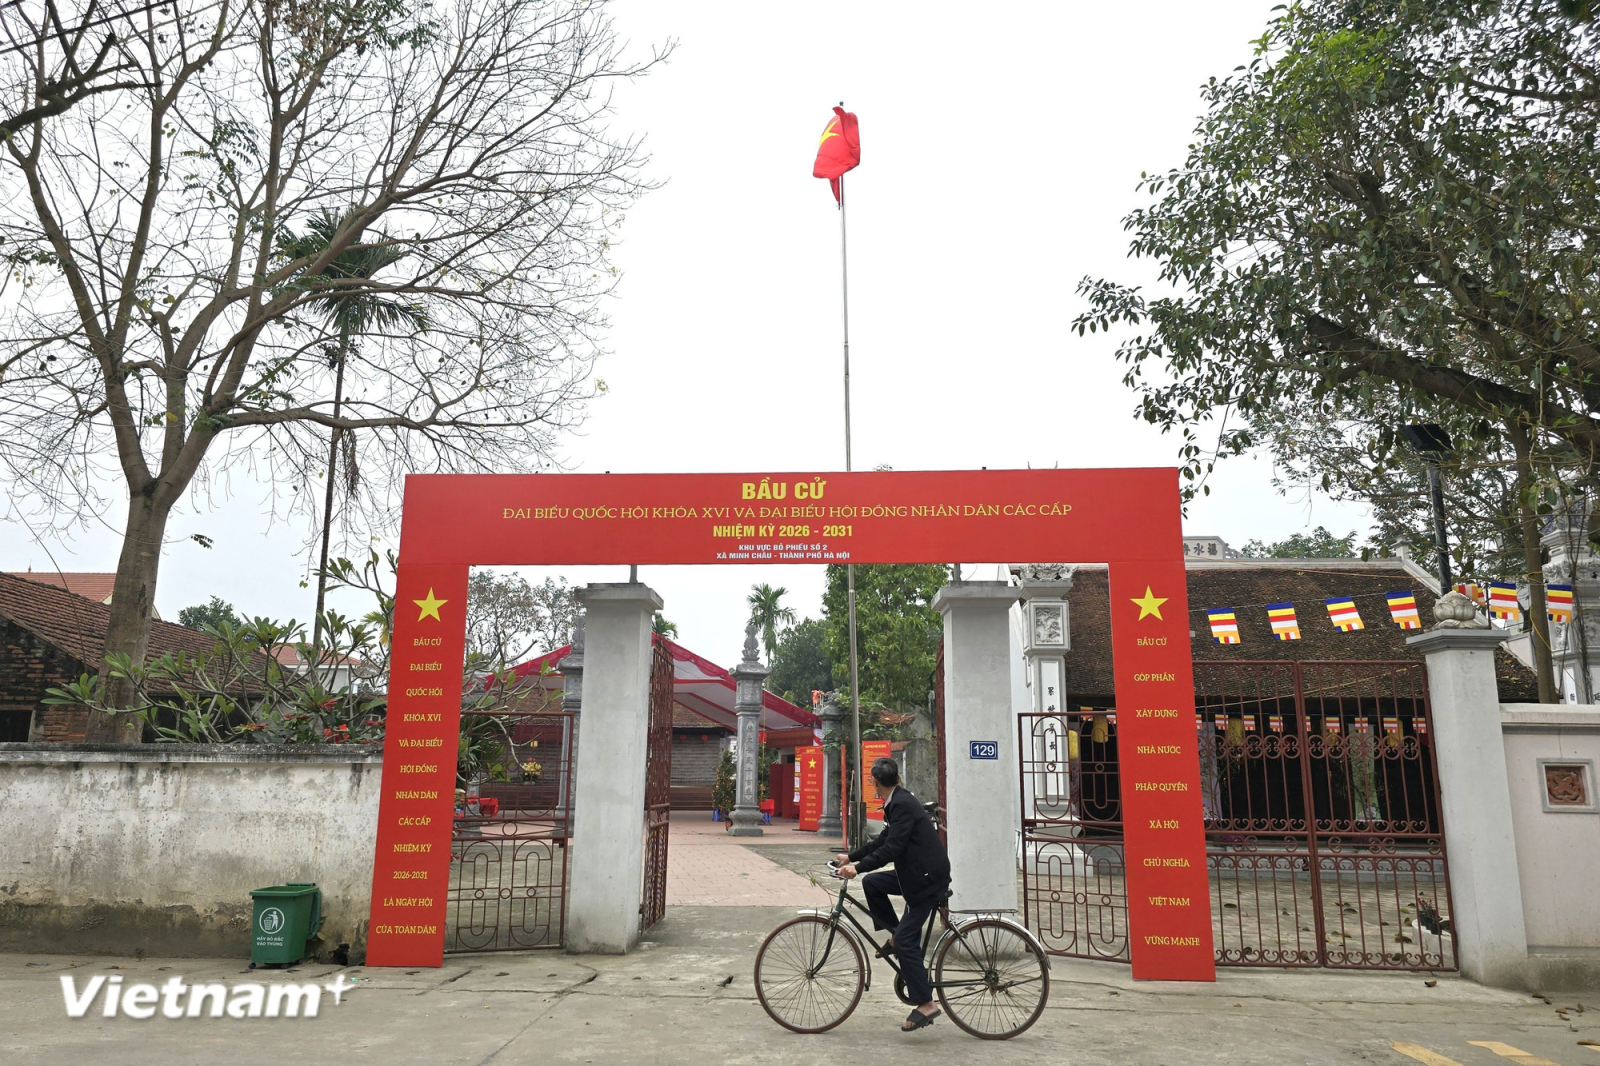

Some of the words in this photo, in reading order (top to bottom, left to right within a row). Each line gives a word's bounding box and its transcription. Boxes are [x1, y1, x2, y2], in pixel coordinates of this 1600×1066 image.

[742, 477, 786, 499] BẦU
[795, 477, 826, 499] CỬ
[503, 508, 531, 520] ĐẠI
[534, 505, 569, 518] BIỂU
[573, 505, 617, 520] QUỐC
[621, 506, 648, 519] HỘI
[653, 506, 698, 518] KHÓA
[702, 507, 729, 518] XVI
[733, 506, 756, 517] VÀ
[759, 507, 787, 519] ĐẠI
[791, 503, 825, 517] BIỂU
[829, 505, 857, 518] HỘI
[861, 503, 907, 517] ĐỒNG
[911, 504, 960, 516] NHÂN
[964, 504, 999, 516] DÂN
[1003, 503, 1036, 515] CÁC
[1039, 502, 1072, 515] CẤP
[713, 523, 755, 539] NHIỆM
[759, 523, 775, 536] KỲ
[779, 525, 810, 536] 2026
[823, 525, 852, 536] 2031
[756, 543, 771, 552] VỰC
[773, 542, 783, 551] BỎ
[786, 542, 808, 551] PHIẾU
[810, 542, 820, 551] SỐ
[717, 551, 727, 559] XÃ
[752, 551, 771, 559] CHÂU
[779, 551, 804, 559] THÀNH
[806, 550, 821, 559] PHỐ
[824, 551, 834, 559] HÀ
[836, 551, 849, 560] NỘI
[414, 636, 430, 647] BẦU
[431, 636, 442, 646] CỬ
[1137, 636, 1154, 646] BẦU
[1156, 636, 1167, 646] CỬ
[410, 663, 424, 671] ĐẠI
[425, 660, 442, 671] BIỂU
[1134, 673, 1150, 682] GÓP
[1151, 671, 1174, 682] PHẦN
[406, 686, 427, 698] QUỐC
[429, 686, 442, 697] HỘI
[404, 713, 425, 722] KHÓA
[427, 713, 441, 722] XVI
[1136, 708, 1152, 718] XÂY
[1154, 708, 1178, 719] DỰNG
[399, 738, 409, 748] VÀ
[411, 739, 424, 748] ĐẠI
[426, 736, 443, 748] BIỂU
[973, 744, 995, 757] 129
[1137, 744, 1156, 754] NHÀ
[1158, 744, 1181, 755] NƯỚC
[400, 763, 414, 774] HỘI
[416, 762, 437, 773] ĐỒNG
[1135, 781, 1157, 791] PHÁP
[1159, 780, 1187, 793] QUYỀN
[396, 789, 419, 800] NHÂN
[421, 789, 437, 800] DÂN
[399, 817, 414, 826] CÁC
[415, 815, 431, 826] CẤP
[1150, 819, 1162, 829] XÃ
[1164, 819, 1179, 830] HỘI
[394, 842, 419, 853] NHIỆM
[421, 843, 431, 853] KỲ
[1144, 856, 1161, 867] CHỦ
[1163, 857, 1190, 868] NGHĨA
[393, 870, 427, 880] 2026-2031
[384, 896, 394, 907] LÀ
[396, 896, 417, 907] NGÀY
[418, 896, 432, 907] HỘI
[1149, 895, 1167, 907] VIỆT
[1169, 897, 1190, 907] NAM
[376, 923, 392, 934] CỦA
[395, 924, 416, 935] TOÀN
[1145, 935, 1169, 946] VỮNG
